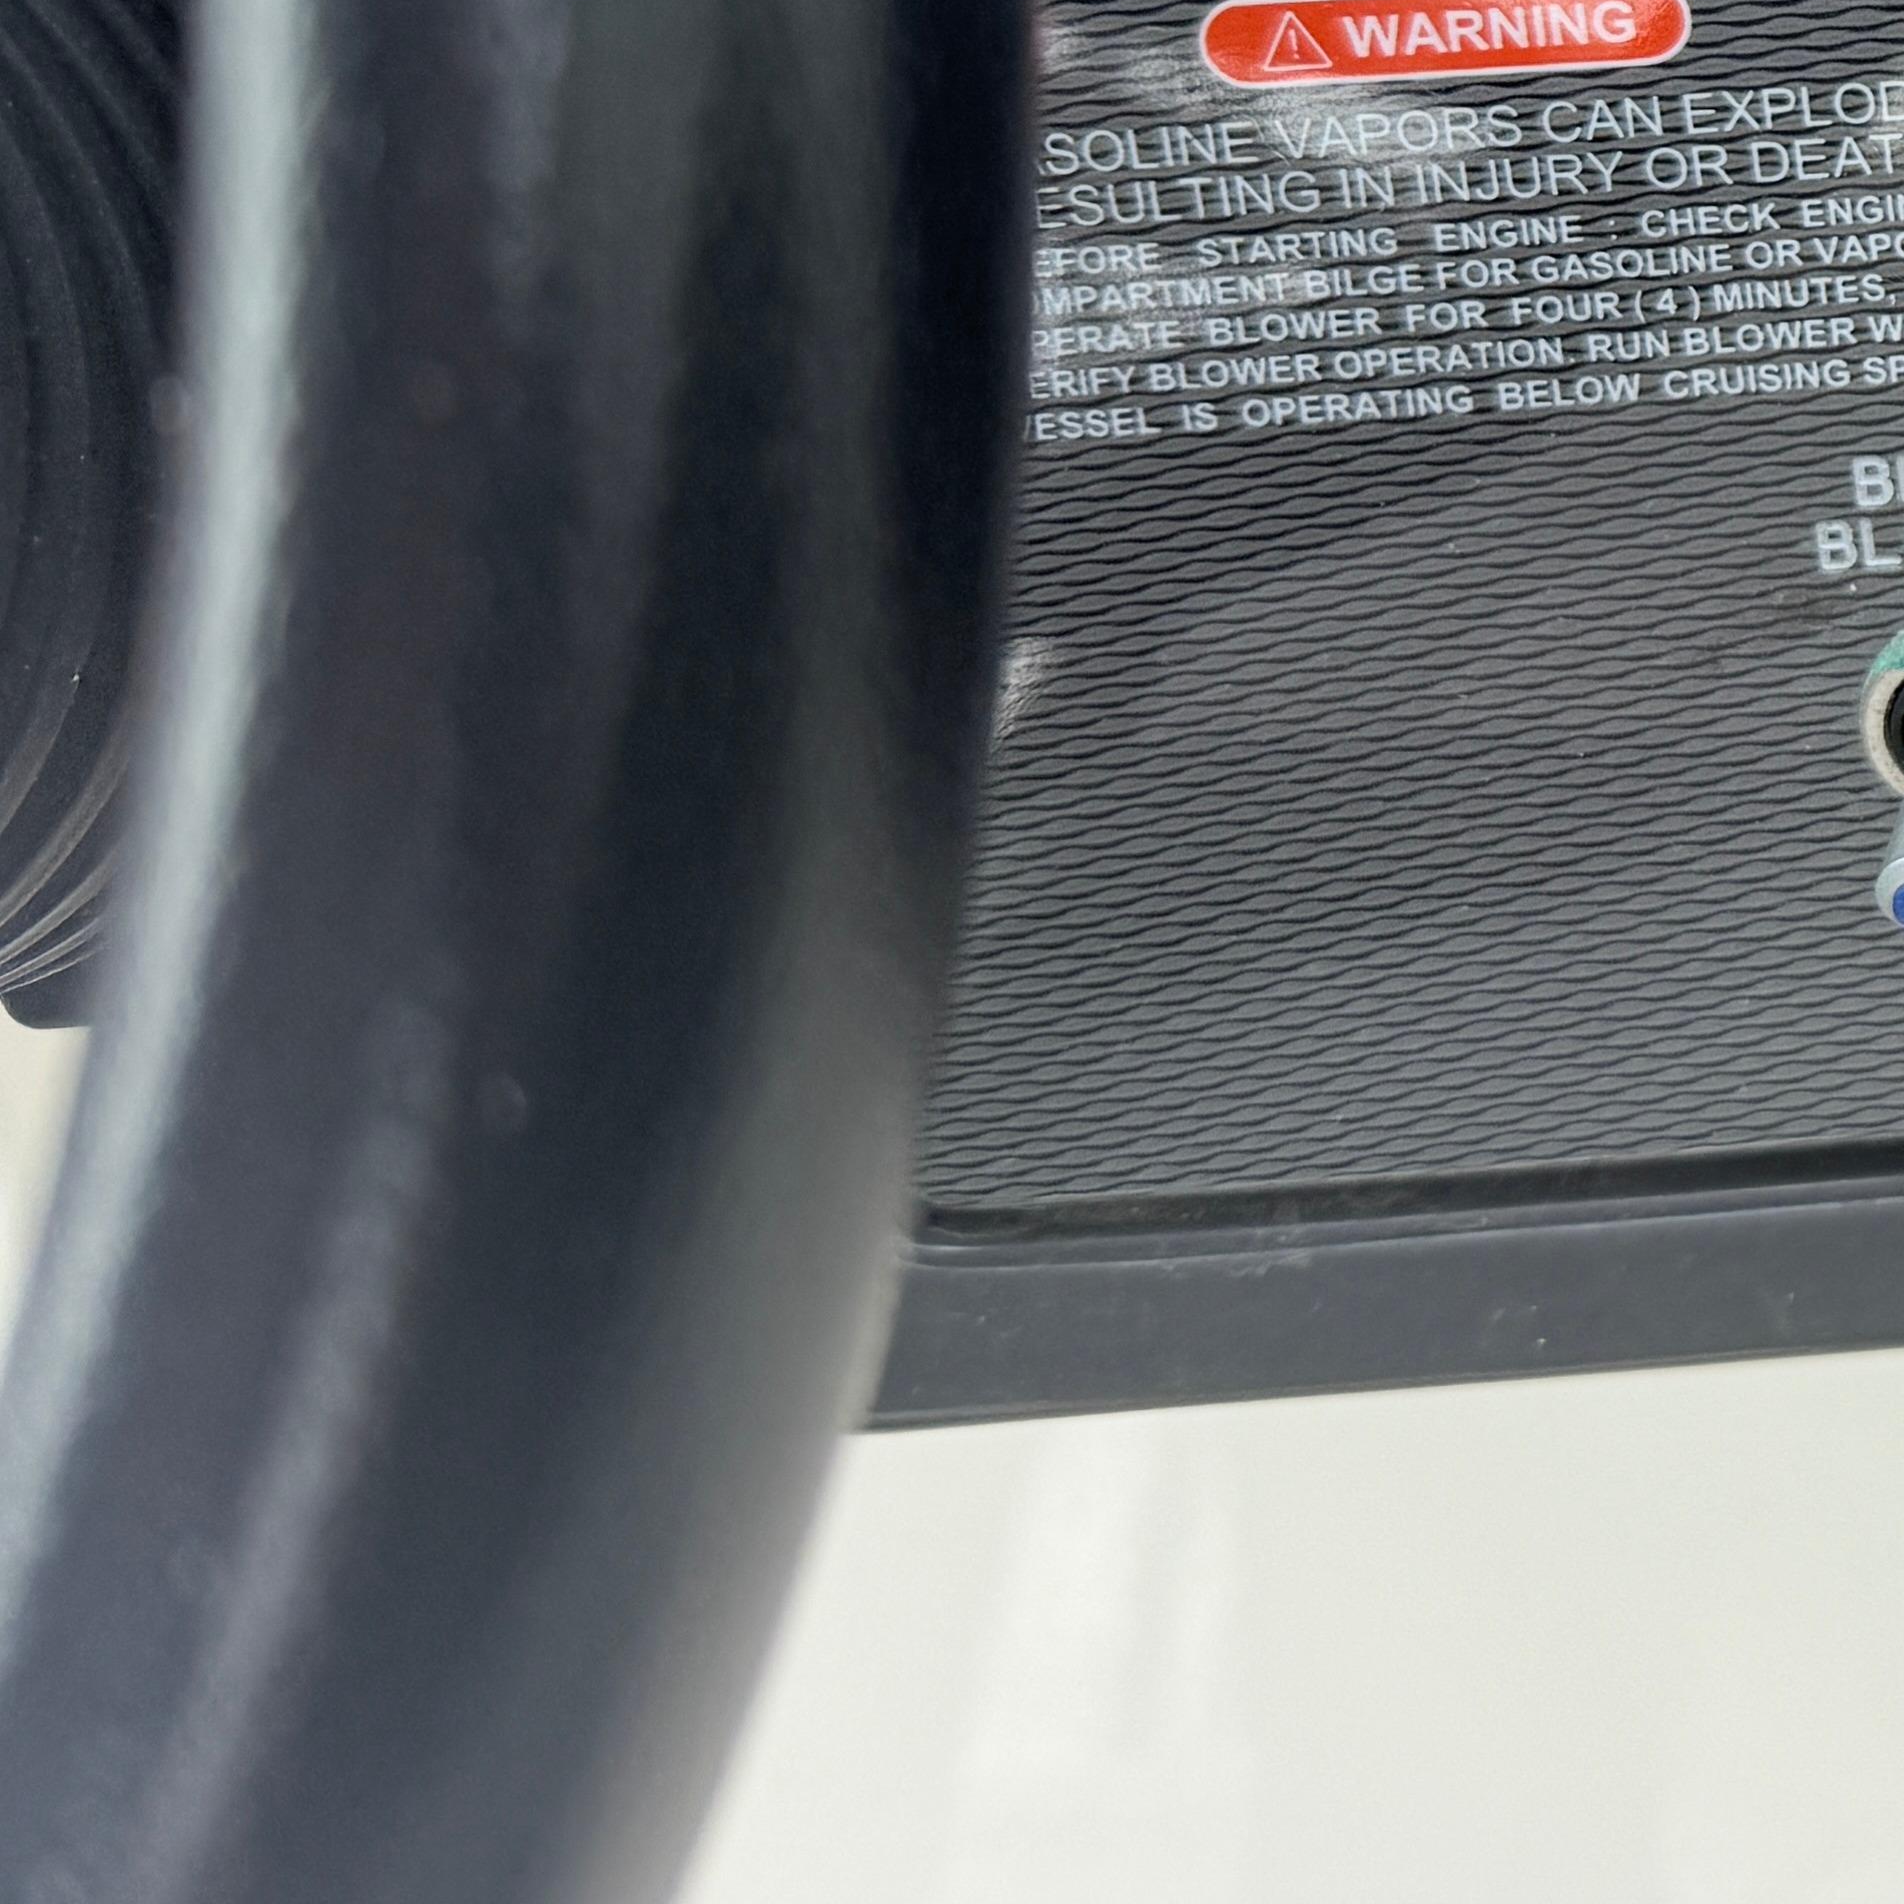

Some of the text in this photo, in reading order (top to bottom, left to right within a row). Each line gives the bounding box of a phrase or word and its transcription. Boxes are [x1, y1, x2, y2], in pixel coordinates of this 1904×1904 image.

[1341, 0, 1637, 59] WARNING
[1037, 121, 1260, 176] SOLINE
[1274, 104, 1523, 159] VAPORS
[1543, 97, 1663, 144] CAN
[1036, 170, 1321, 229] ESULTING
[1337, 167, 1396, 210] IN
[1412, 150, 1623, 205] INJURY
[1645, 143, 1735, 191] OR
[1033, 272, 1289, 316] MPARTMENT
[1305, 263, 1425, 300] BILGE
[1437, 257, 1518, 291] FOR
[1531, 244, 1733, 282] GASOLINE
[1745, 238, 1801, 270] OR
[1034, 243, 1162, 277] EFORE
[1198, 227, 1398, 269] STARTING
[1434, 215, 1584, 253] ENGINE
[1640, 202, 1781, 239] CHECK
[1031, 321, 1184, 355] PERATE
[1209, 306, 1380, 345] BLOWER
[1406, 300, 1488, 332] FOR
[1511, 291, 1621, 325] FOUR
[1031, 365, 1135, 399] ERIFY
[1151, 353, 1322, 393] BLOWER
[1588, 328, 1671, 363] RUN
[1684, 315, 1857, 358] BLOWER
[1024, 407, 1162, 442] ESSEL
[1182, 401, 1218, 432] IS
[1241, 383, 1475, 429] OPERATING
[1498, 372, 1642, 413] BELOW
[1663, 357, 1852, 398] CRUISING
